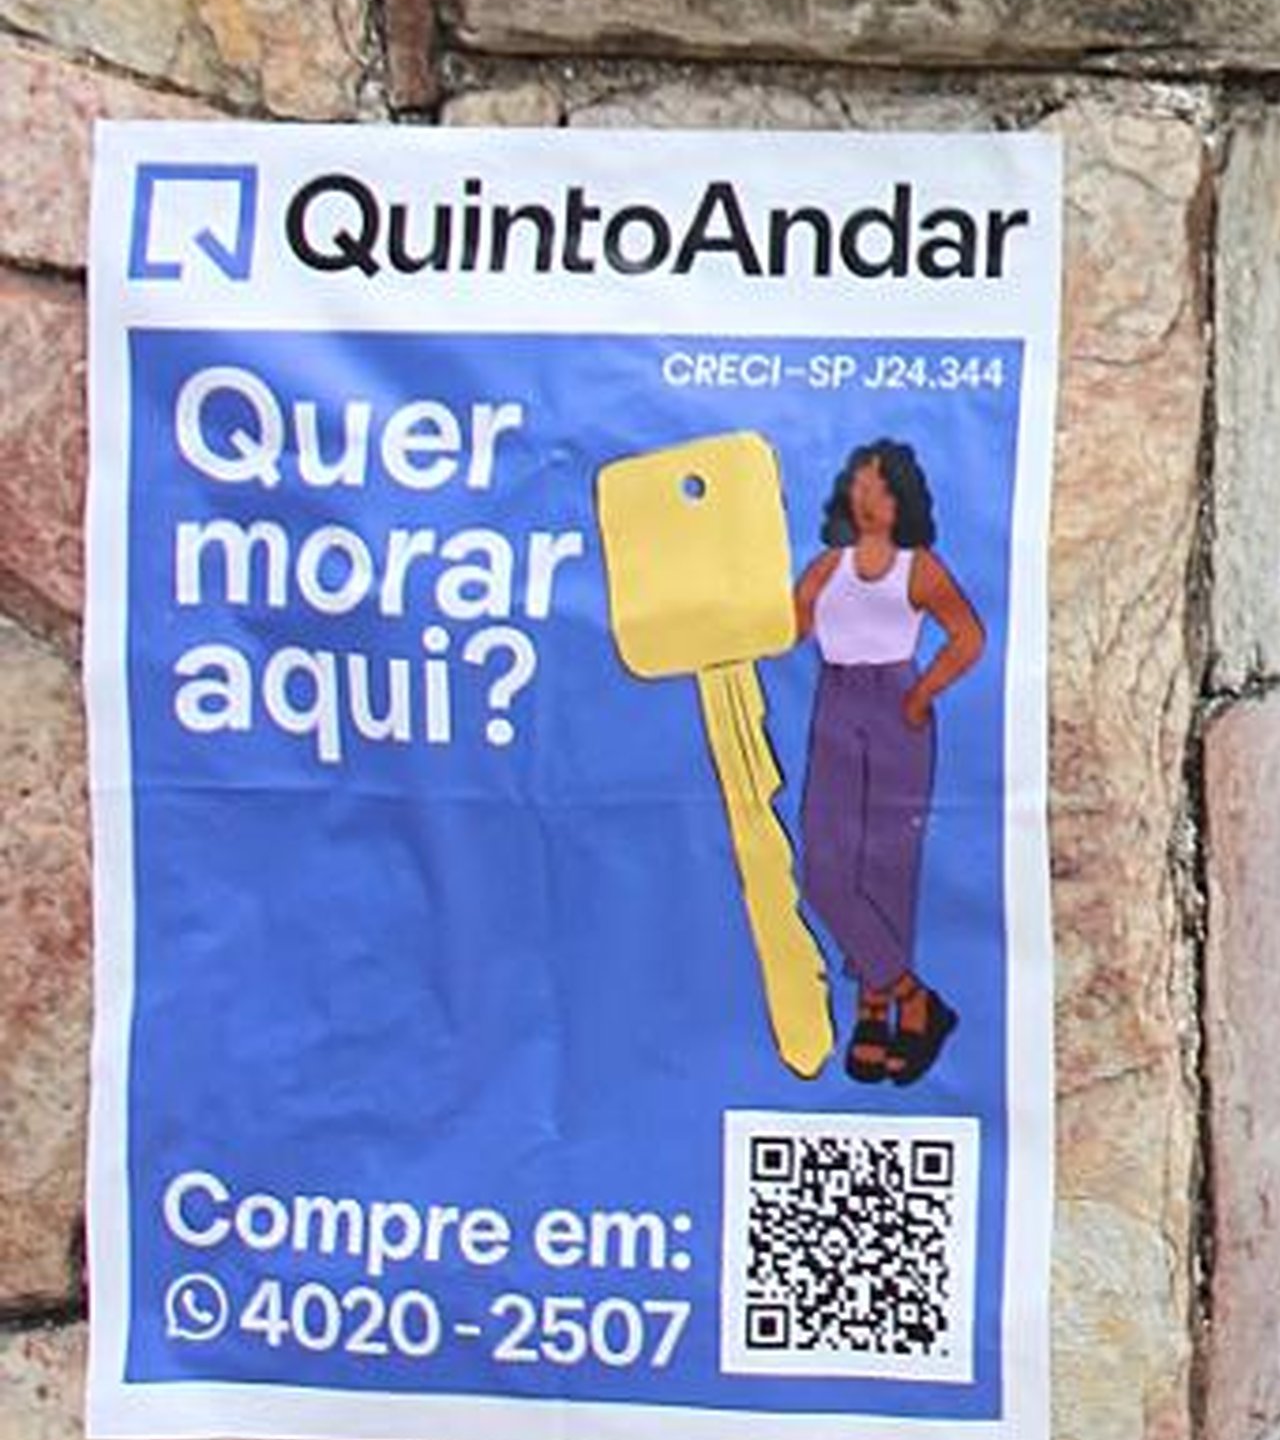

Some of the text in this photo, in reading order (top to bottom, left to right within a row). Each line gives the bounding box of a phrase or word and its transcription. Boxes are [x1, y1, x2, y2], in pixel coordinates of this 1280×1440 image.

[285, 172, 1030, 280] QuintoAndar
[661, 351, 1004, 391] CRECI-SP J24.344
[174, 365, 523, 490] Quer
[175, 518, 583, 623] morar
[173, 625, 539, 763] aqui?
[162, 1170, 693, 1276] Compre em:
[239, 1279, 692, 1368] 4020-2507
